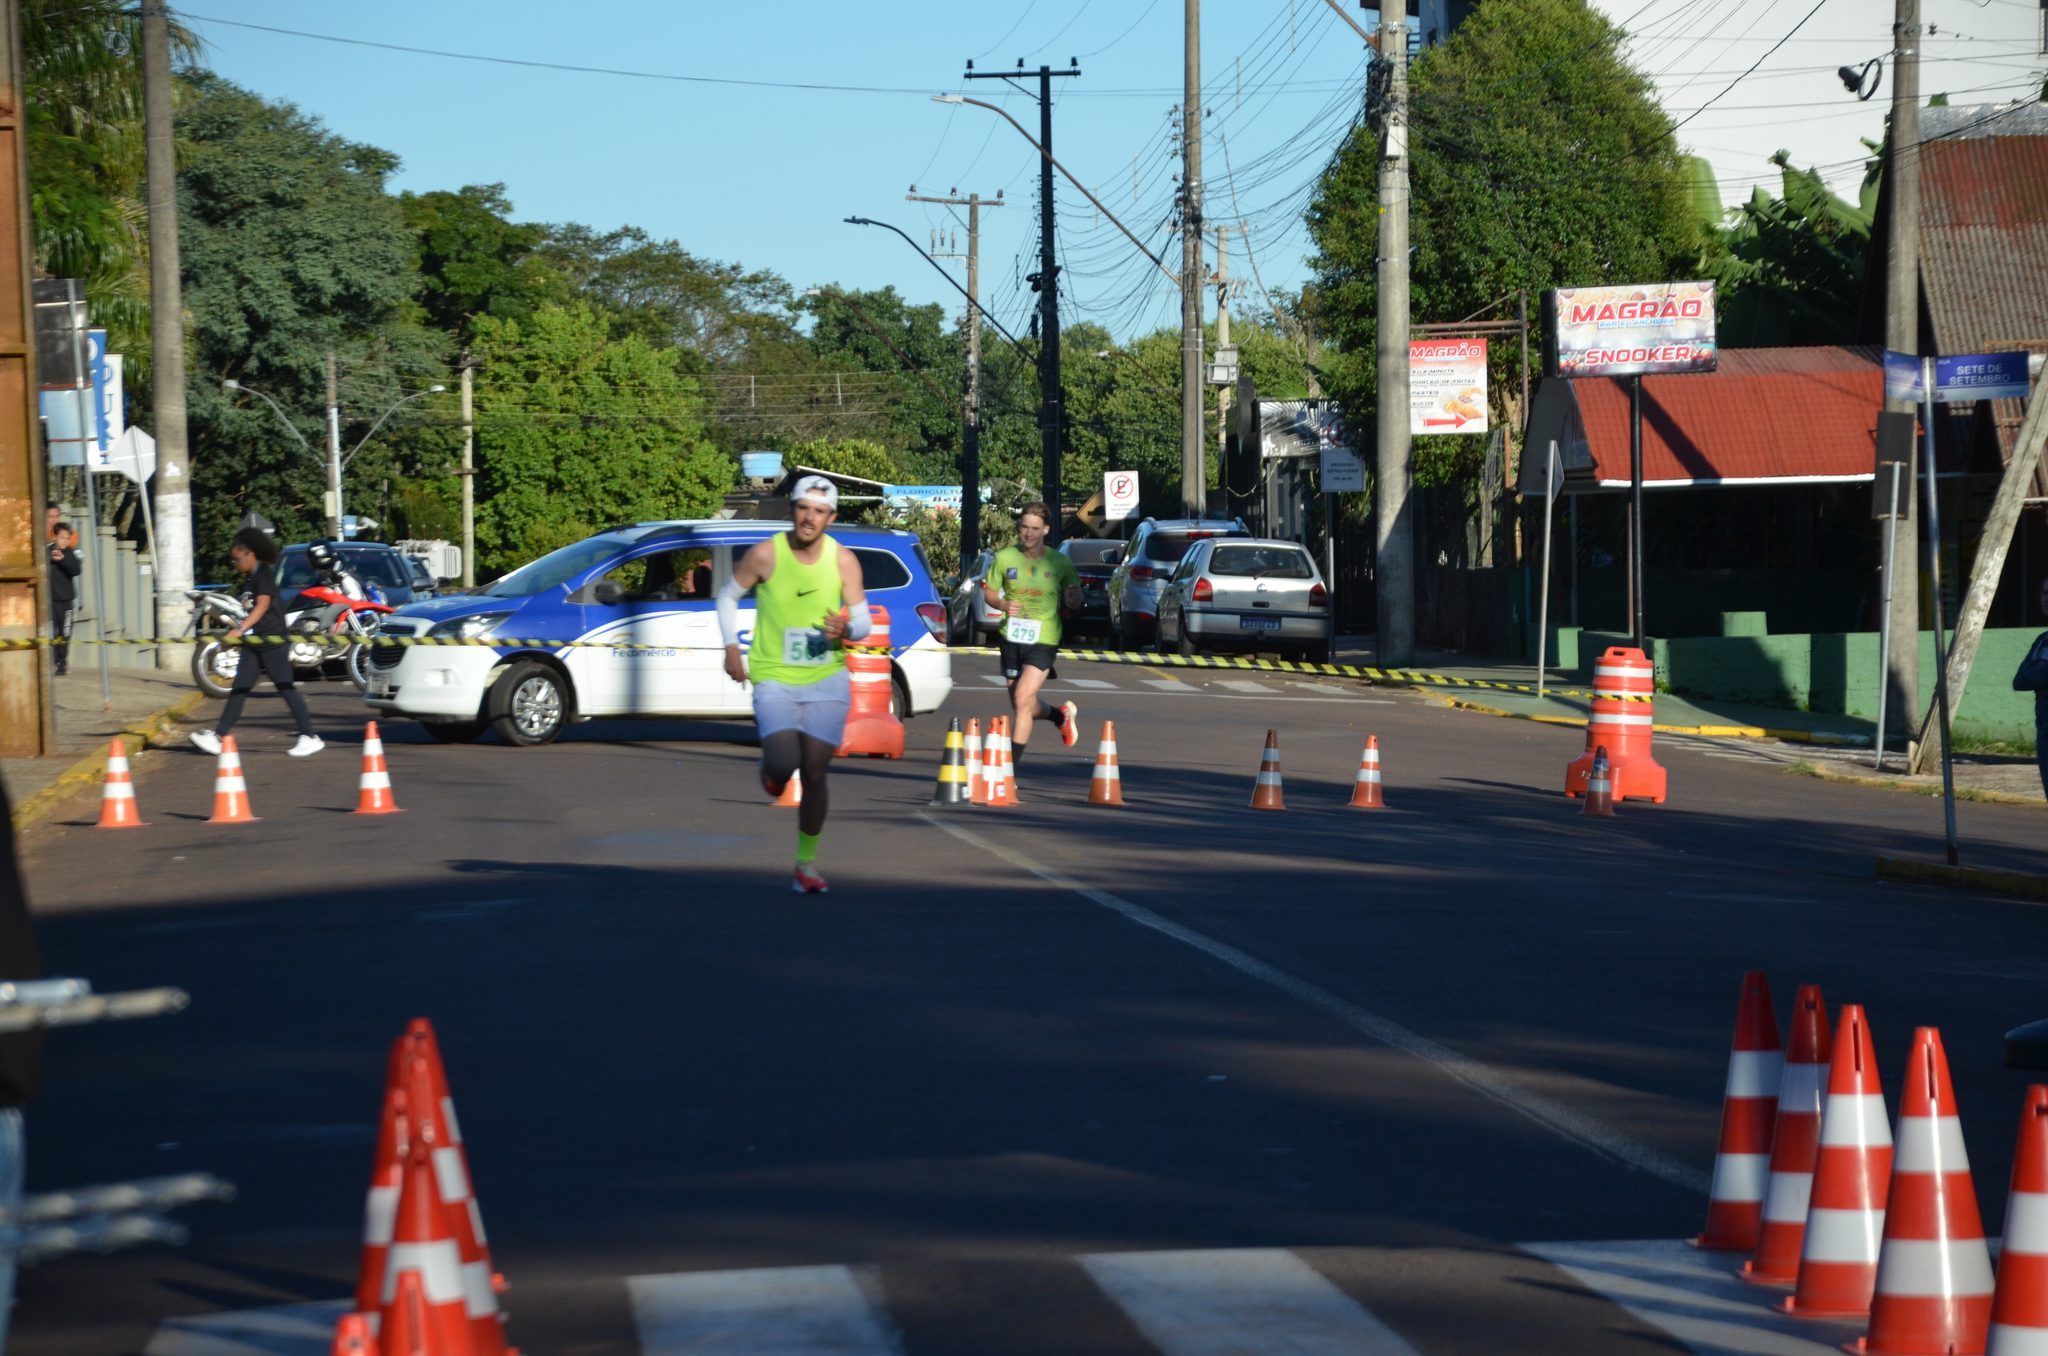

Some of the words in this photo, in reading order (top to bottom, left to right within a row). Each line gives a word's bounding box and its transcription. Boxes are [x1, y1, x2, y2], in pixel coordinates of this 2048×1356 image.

[1571, 294, 1702, 323] MAGRÃO
[1411, 343, 1481, 358] MAGRÃO
[1585, 346, 1692, 364] SNOOKER
[1956, 365, 1985, 375] SETE
[1987, 363, 2002, 373] DE
[1949, 373, 2010, 385] SETEMBRO
[1012, 627, 1036, 641] 479
